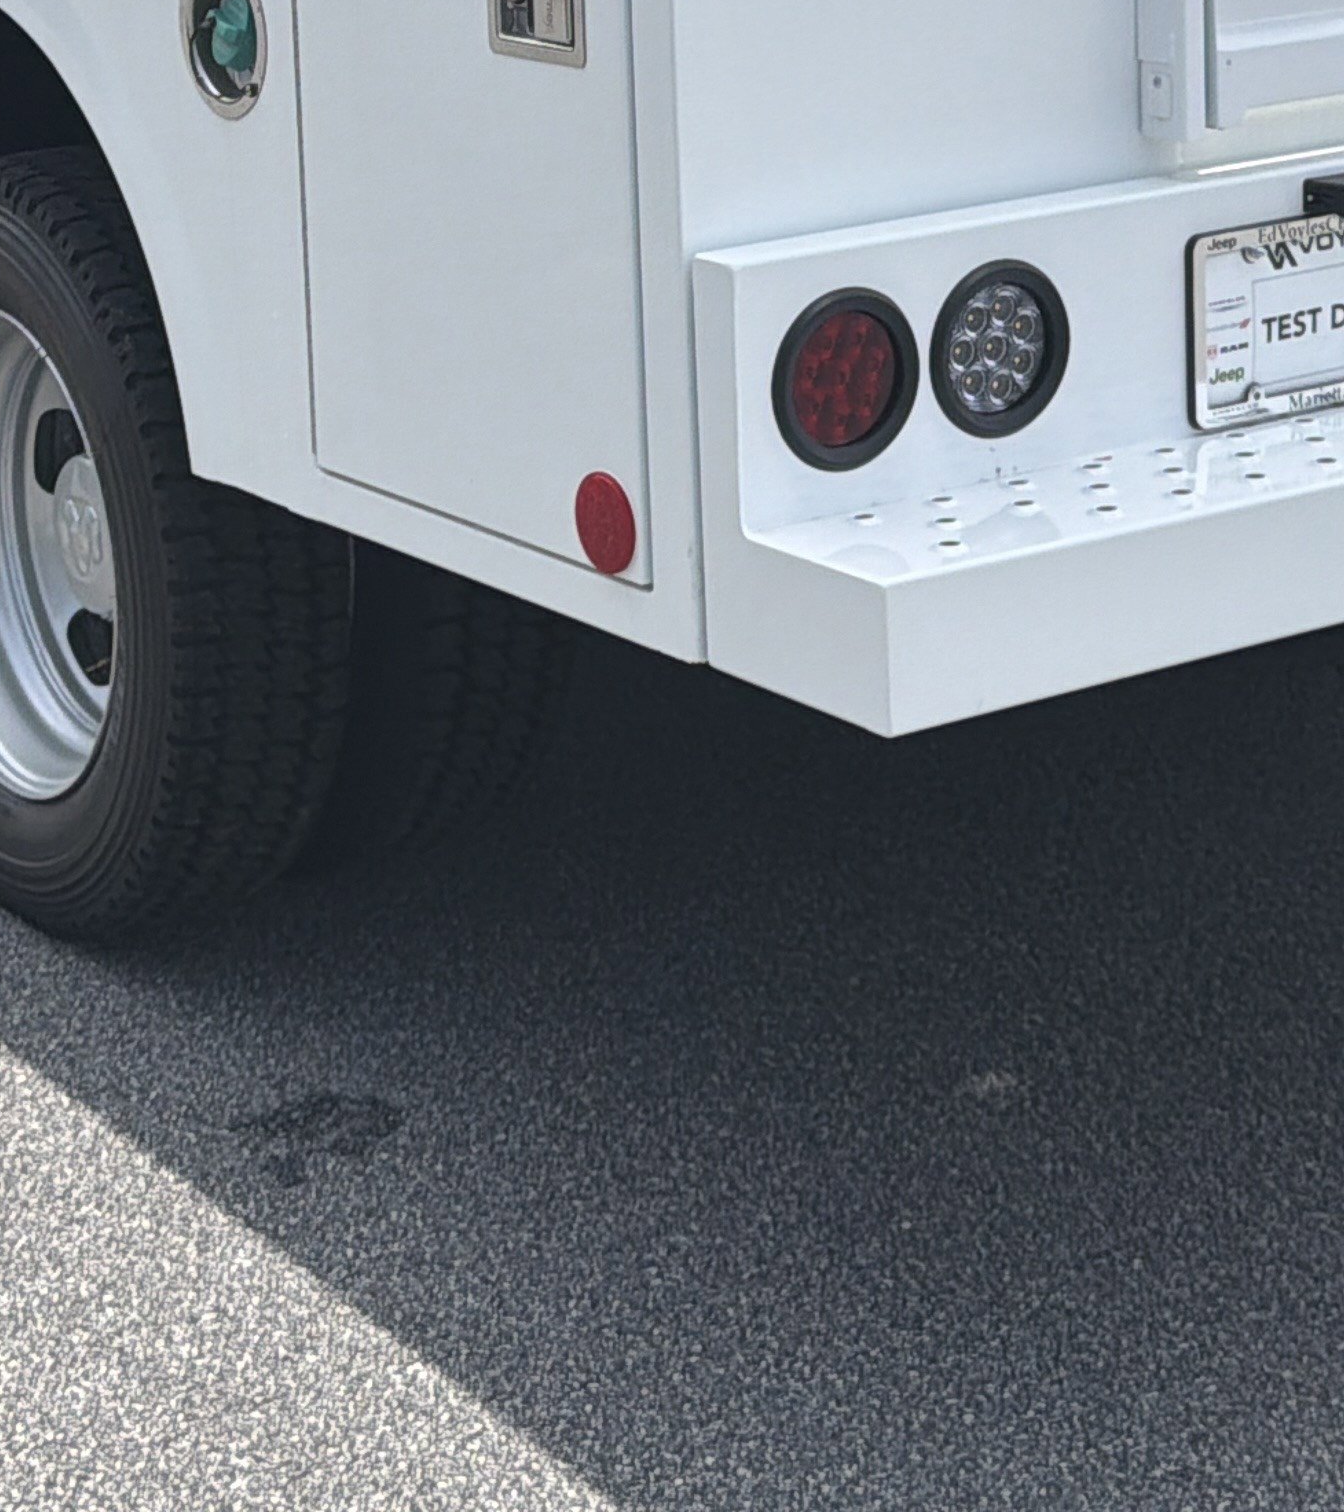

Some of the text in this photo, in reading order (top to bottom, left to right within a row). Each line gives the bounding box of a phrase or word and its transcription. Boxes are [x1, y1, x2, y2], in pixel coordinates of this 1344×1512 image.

[1206, 236, 1238, 252] Jeep
[1261, 305, 1323, 344] TEST
[1209, 366, 1246, 386] Jeep
